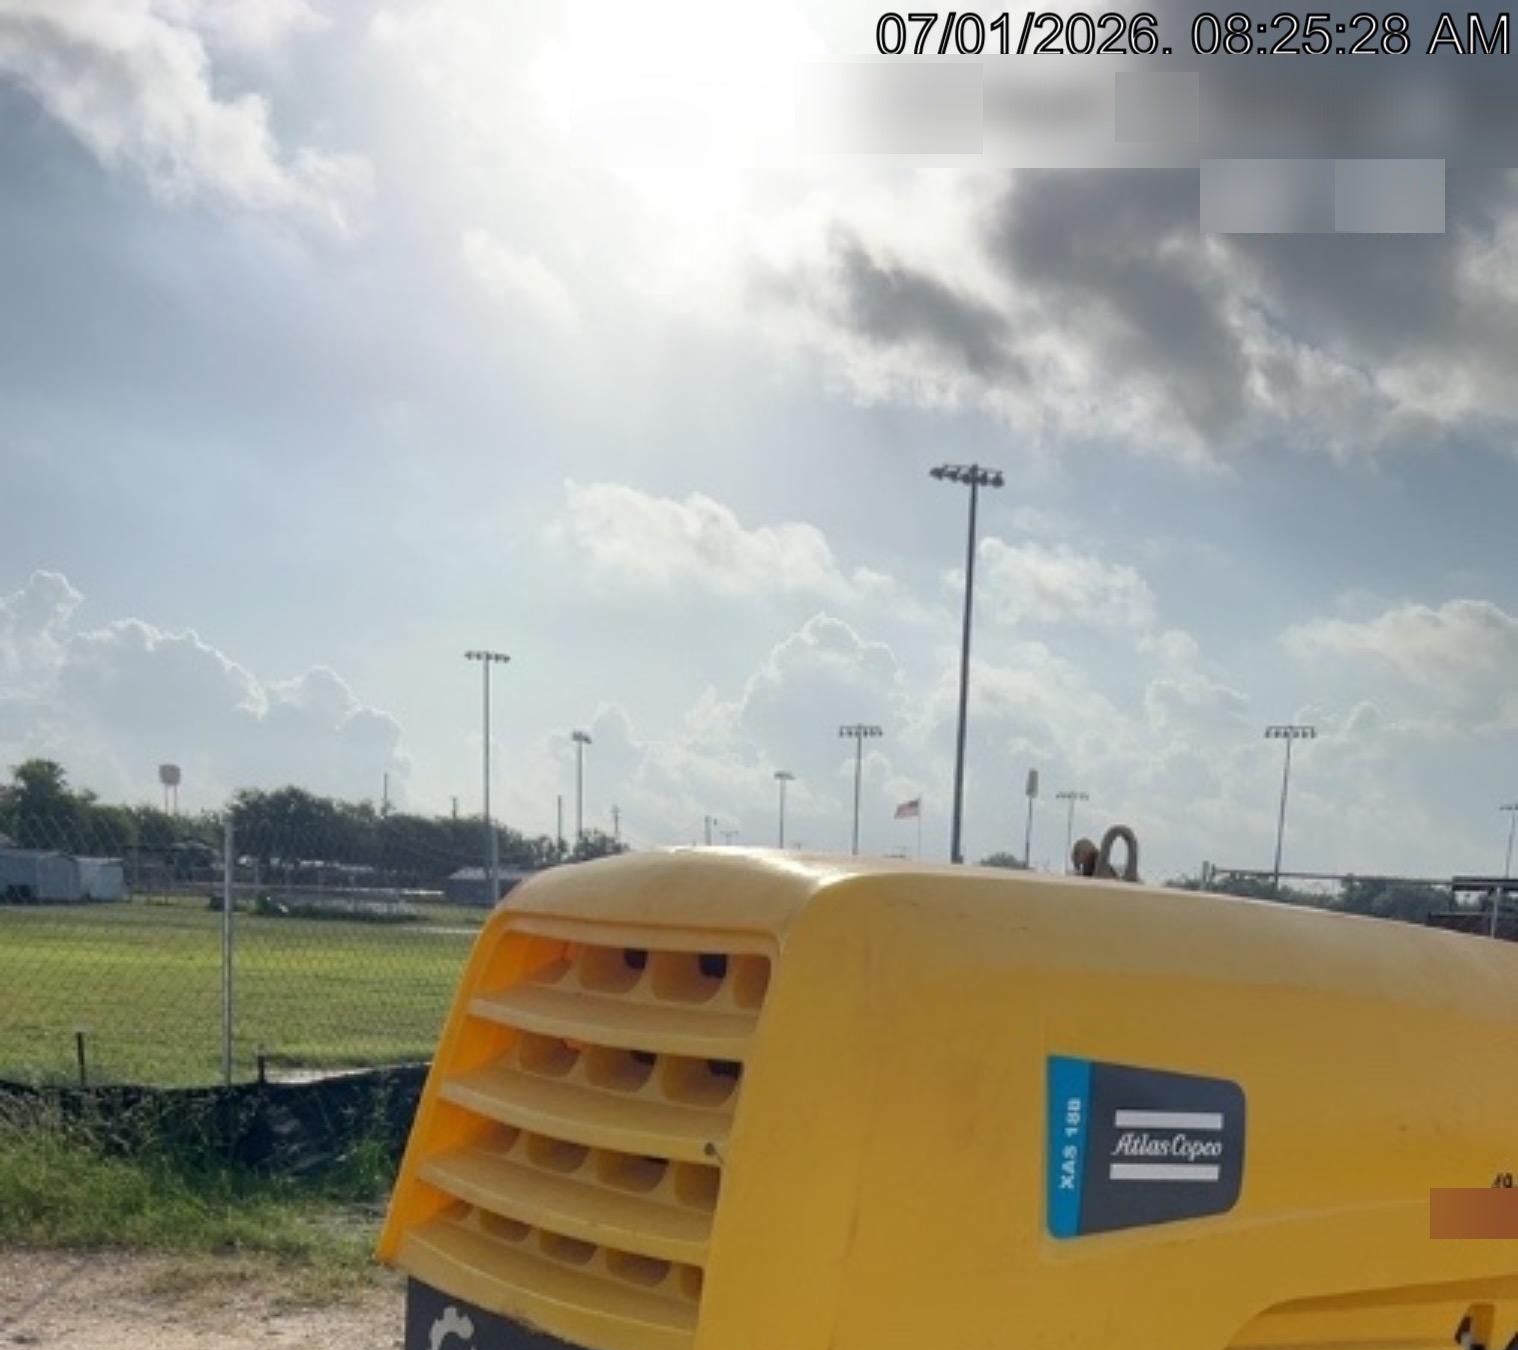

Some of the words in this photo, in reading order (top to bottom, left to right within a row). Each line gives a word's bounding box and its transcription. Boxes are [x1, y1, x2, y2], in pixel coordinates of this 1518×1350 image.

[1110, 1132, 1170, 1156] Atlas
[1171, 1133, 1223, 1162] Copco
[1058, 1145, 1078, 1189] XAS
